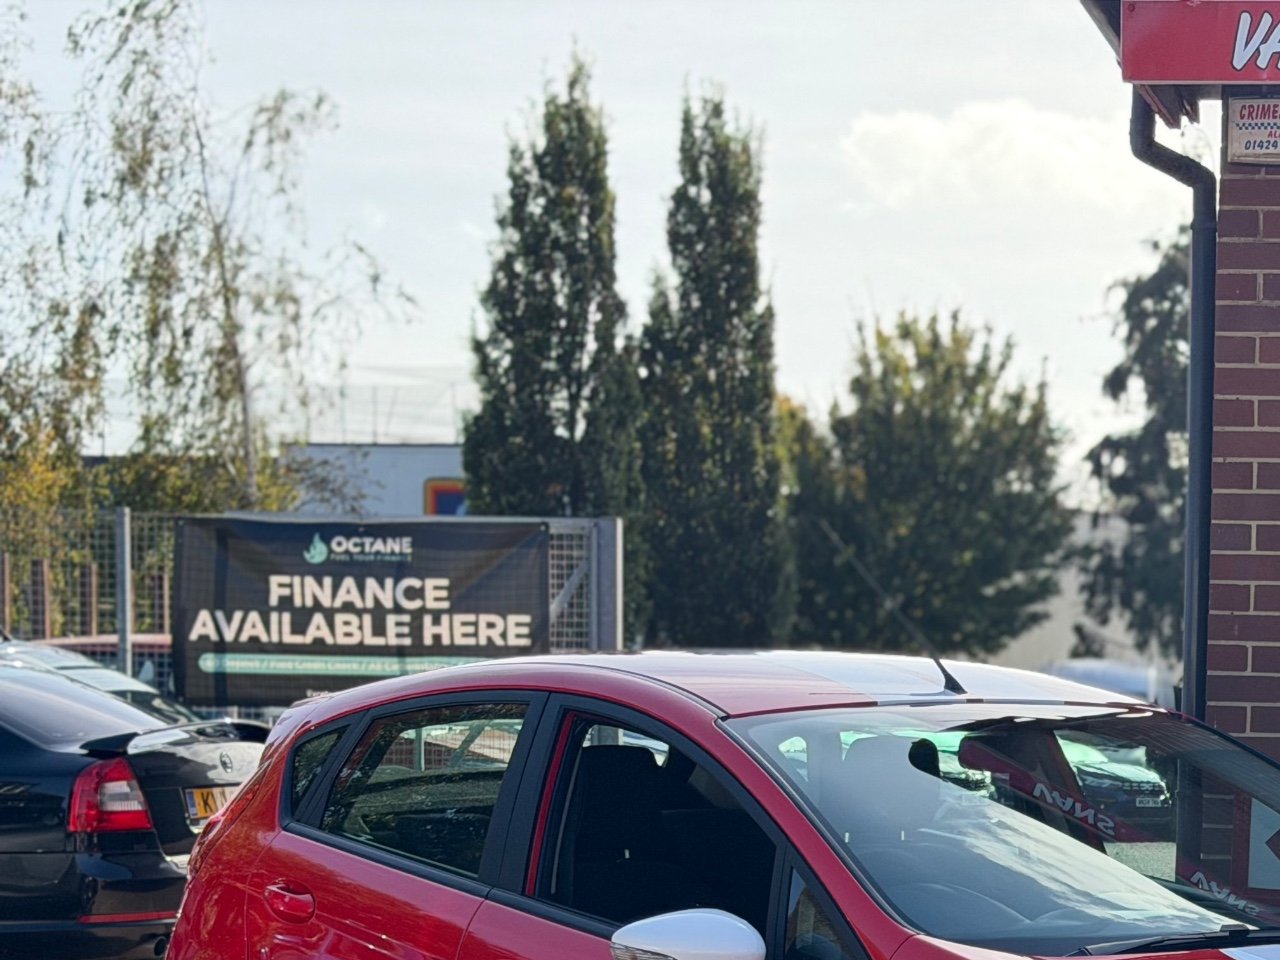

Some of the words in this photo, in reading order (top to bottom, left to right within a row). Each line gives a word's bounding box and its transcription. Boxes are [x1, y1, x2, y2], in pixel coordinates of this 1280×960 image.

[1244, 140, 1278, 150] 01424
[330, 535, 412, 554] OCTANE
[268, 574, 451, 610] FINANCE
[188, 609, 412, 647] AVAILABLE
[423, 614, 532, 647] HERE
